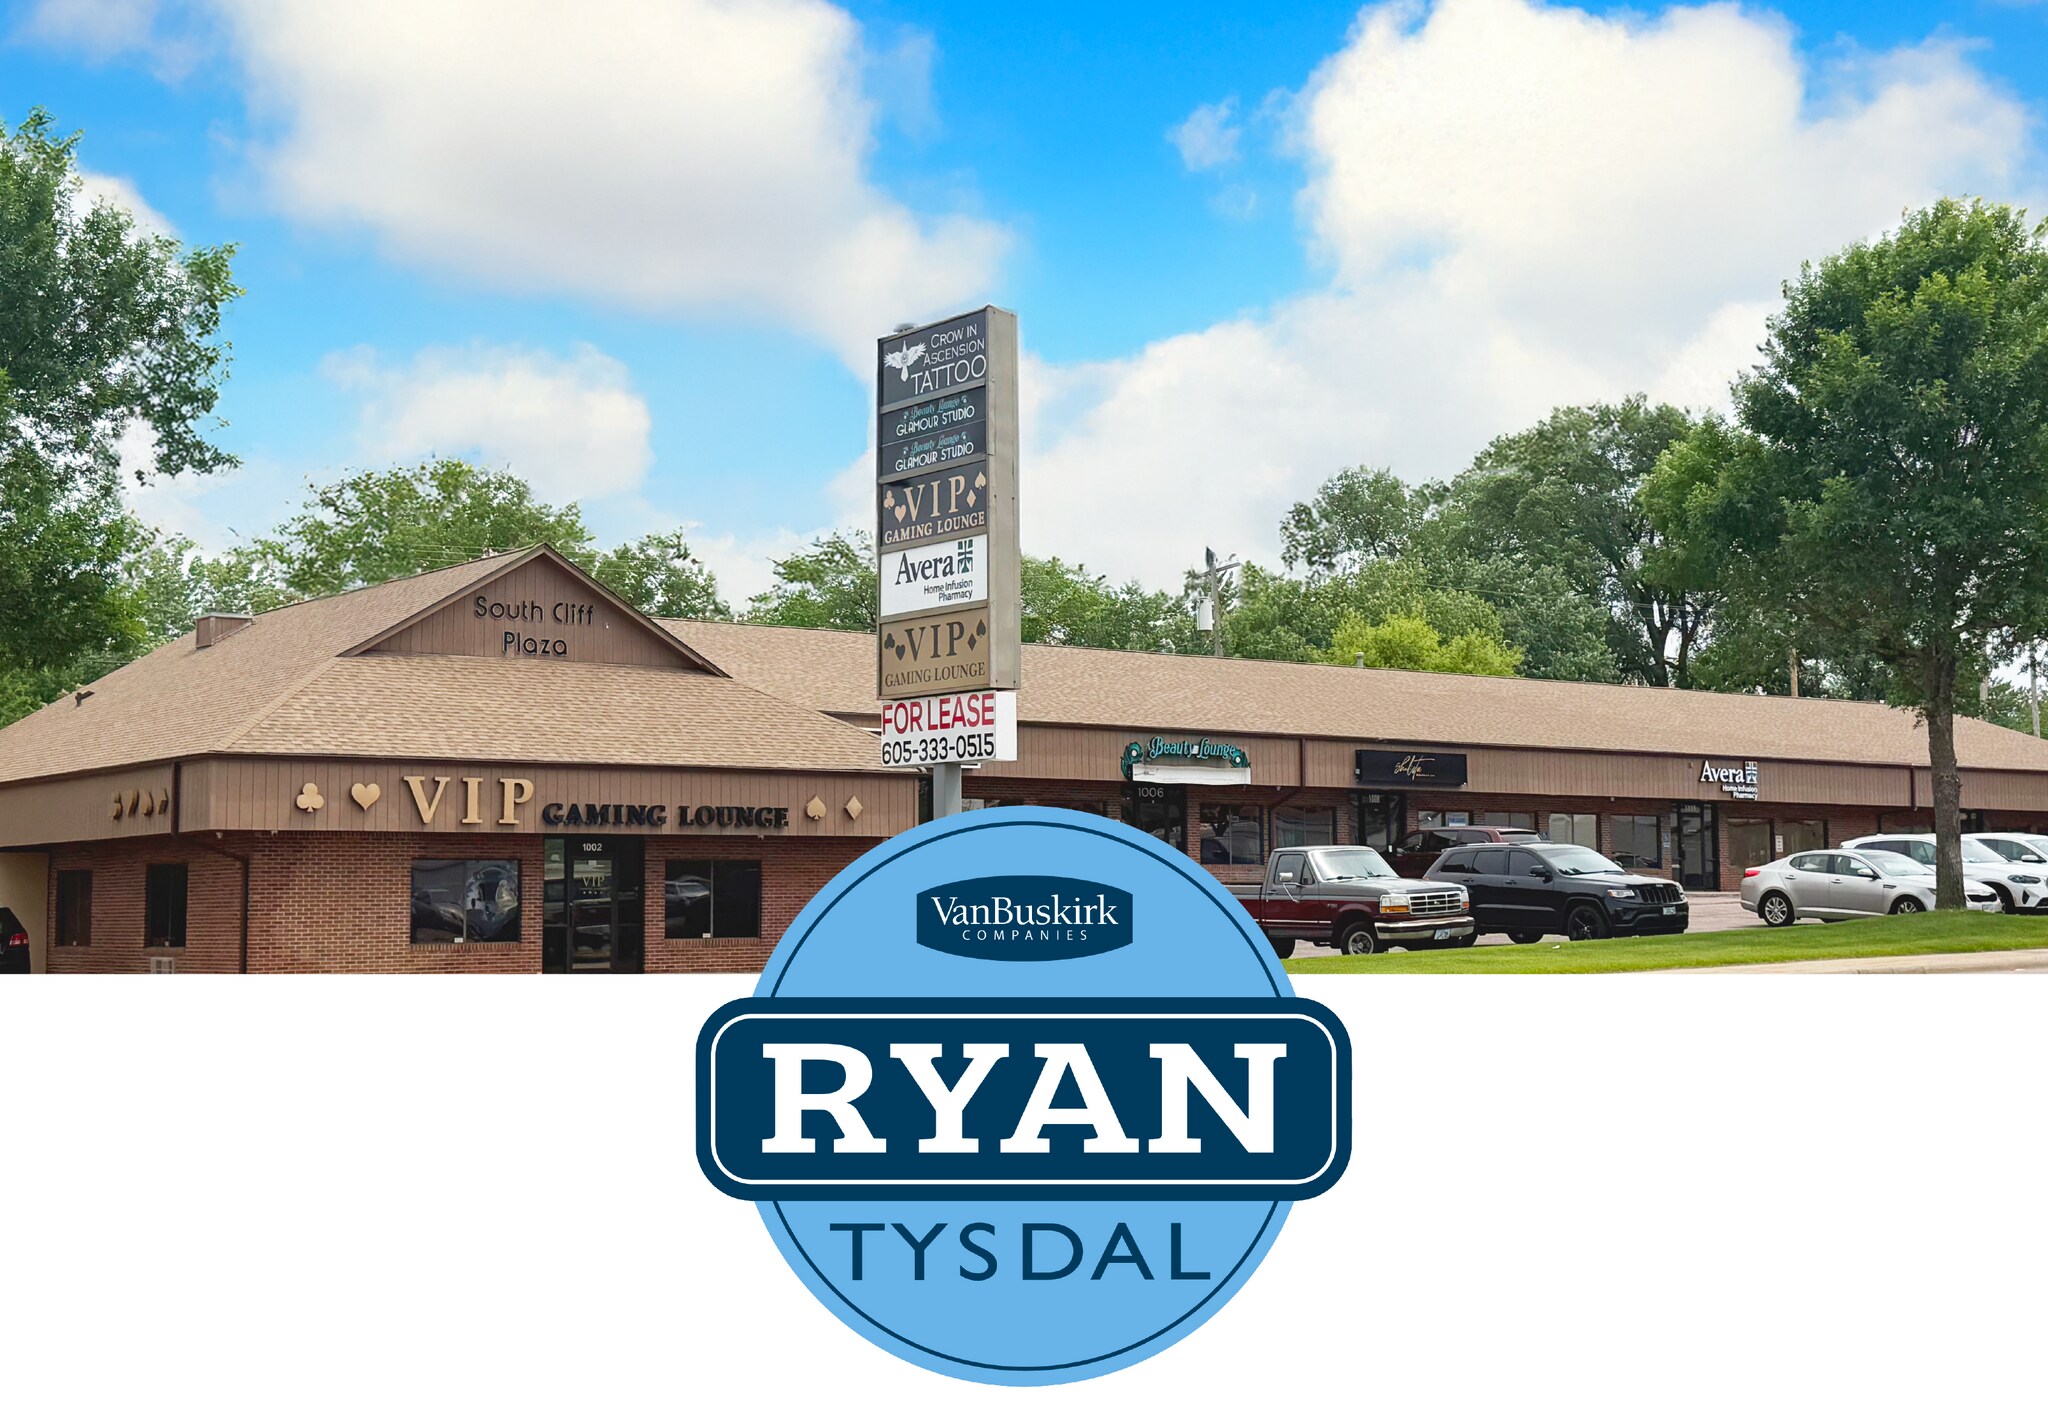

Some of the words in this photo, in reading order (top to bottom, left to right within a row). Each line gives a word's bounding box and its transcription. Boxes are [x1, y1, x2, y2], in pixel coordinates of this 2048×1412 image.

[931, 327, 964, 348] CROW
[966, 324, 978, 338] IN
[923, 338, 985, 367] ASCENSION
[911, 355, 987, 395] TATTOO
[896, 416, 938, 436] GLAMOUR
[942, 406, 975, 425] STUDIO
[895, 452, 938, 472] GLAMOUR
[941, 442, 974, 461] STUDIO
[904, 475, 966, 522] VIP
[884, 522, 932, 544] GAMING
[938, 511, 985, 534] LOUNGE
[895, 552, 955, 586] Avera
[924, 584, 944, 595] Home
[945, 579, 973, 591] Infusion
[938, 589, 973, 602] Pharmacy
[474, 596, 543, 621] South
[553, 602, 594, 625] Cliff
[503, 631, 567, 656] Plaza
[904, 621, 965, 662] VIP
[885, 669, 931, 687] GAMING
[934, 662, 985, 681] LOUNGE
[882, 701, 923, 736] FOR
[928, 693, 994, 731] LEASE
[882, 733, 994, 765] 605-333-0515
[1148, 736, 1193, 759] Beauty
[1197, 738, 1236, 759] Lounge
[1700, 760, 1745, 783] Avera
[403, 776, 534, 825] VIP
[542, 803, 668, 828] GAMING
[679, 805, 790, 828] LOUNGE
[1138, 788, 1164, 798] 1006
[1733, 792, 1758, 800] Pharmacy
[582, 843, 602, 852] 1002
[582, 875, 605, 887] VIP
